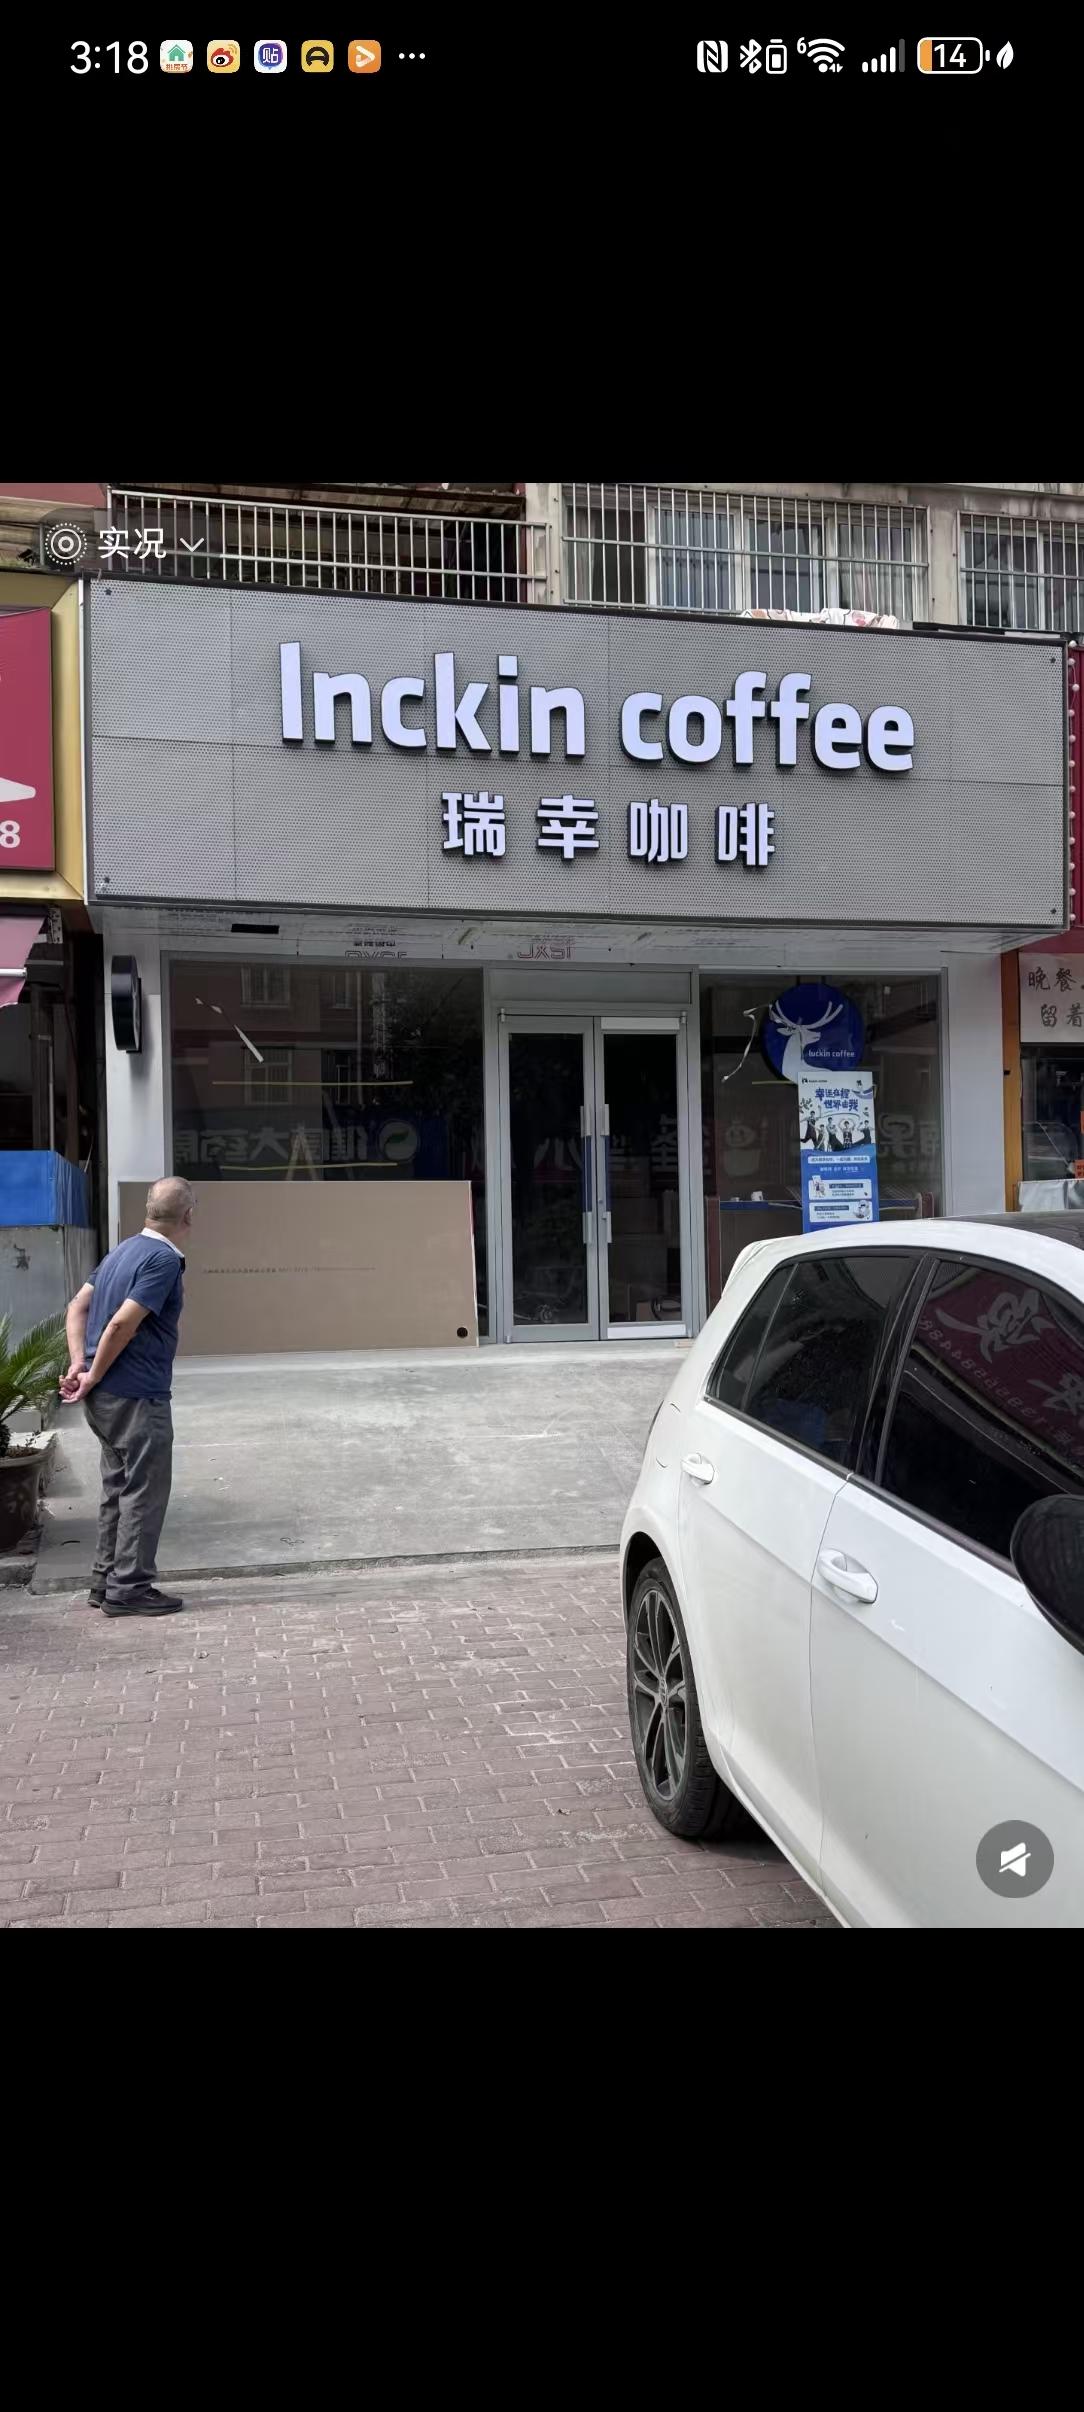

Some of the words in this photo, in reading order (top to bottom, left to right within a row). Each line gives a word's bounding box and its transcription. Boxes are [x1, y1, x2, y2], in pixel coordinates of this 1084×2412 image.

[620, 671, 915, 772] coffee
[441, 790, 776, 868] 瑞幸咖啡
[832, 1049, 855, 1058] coffee
